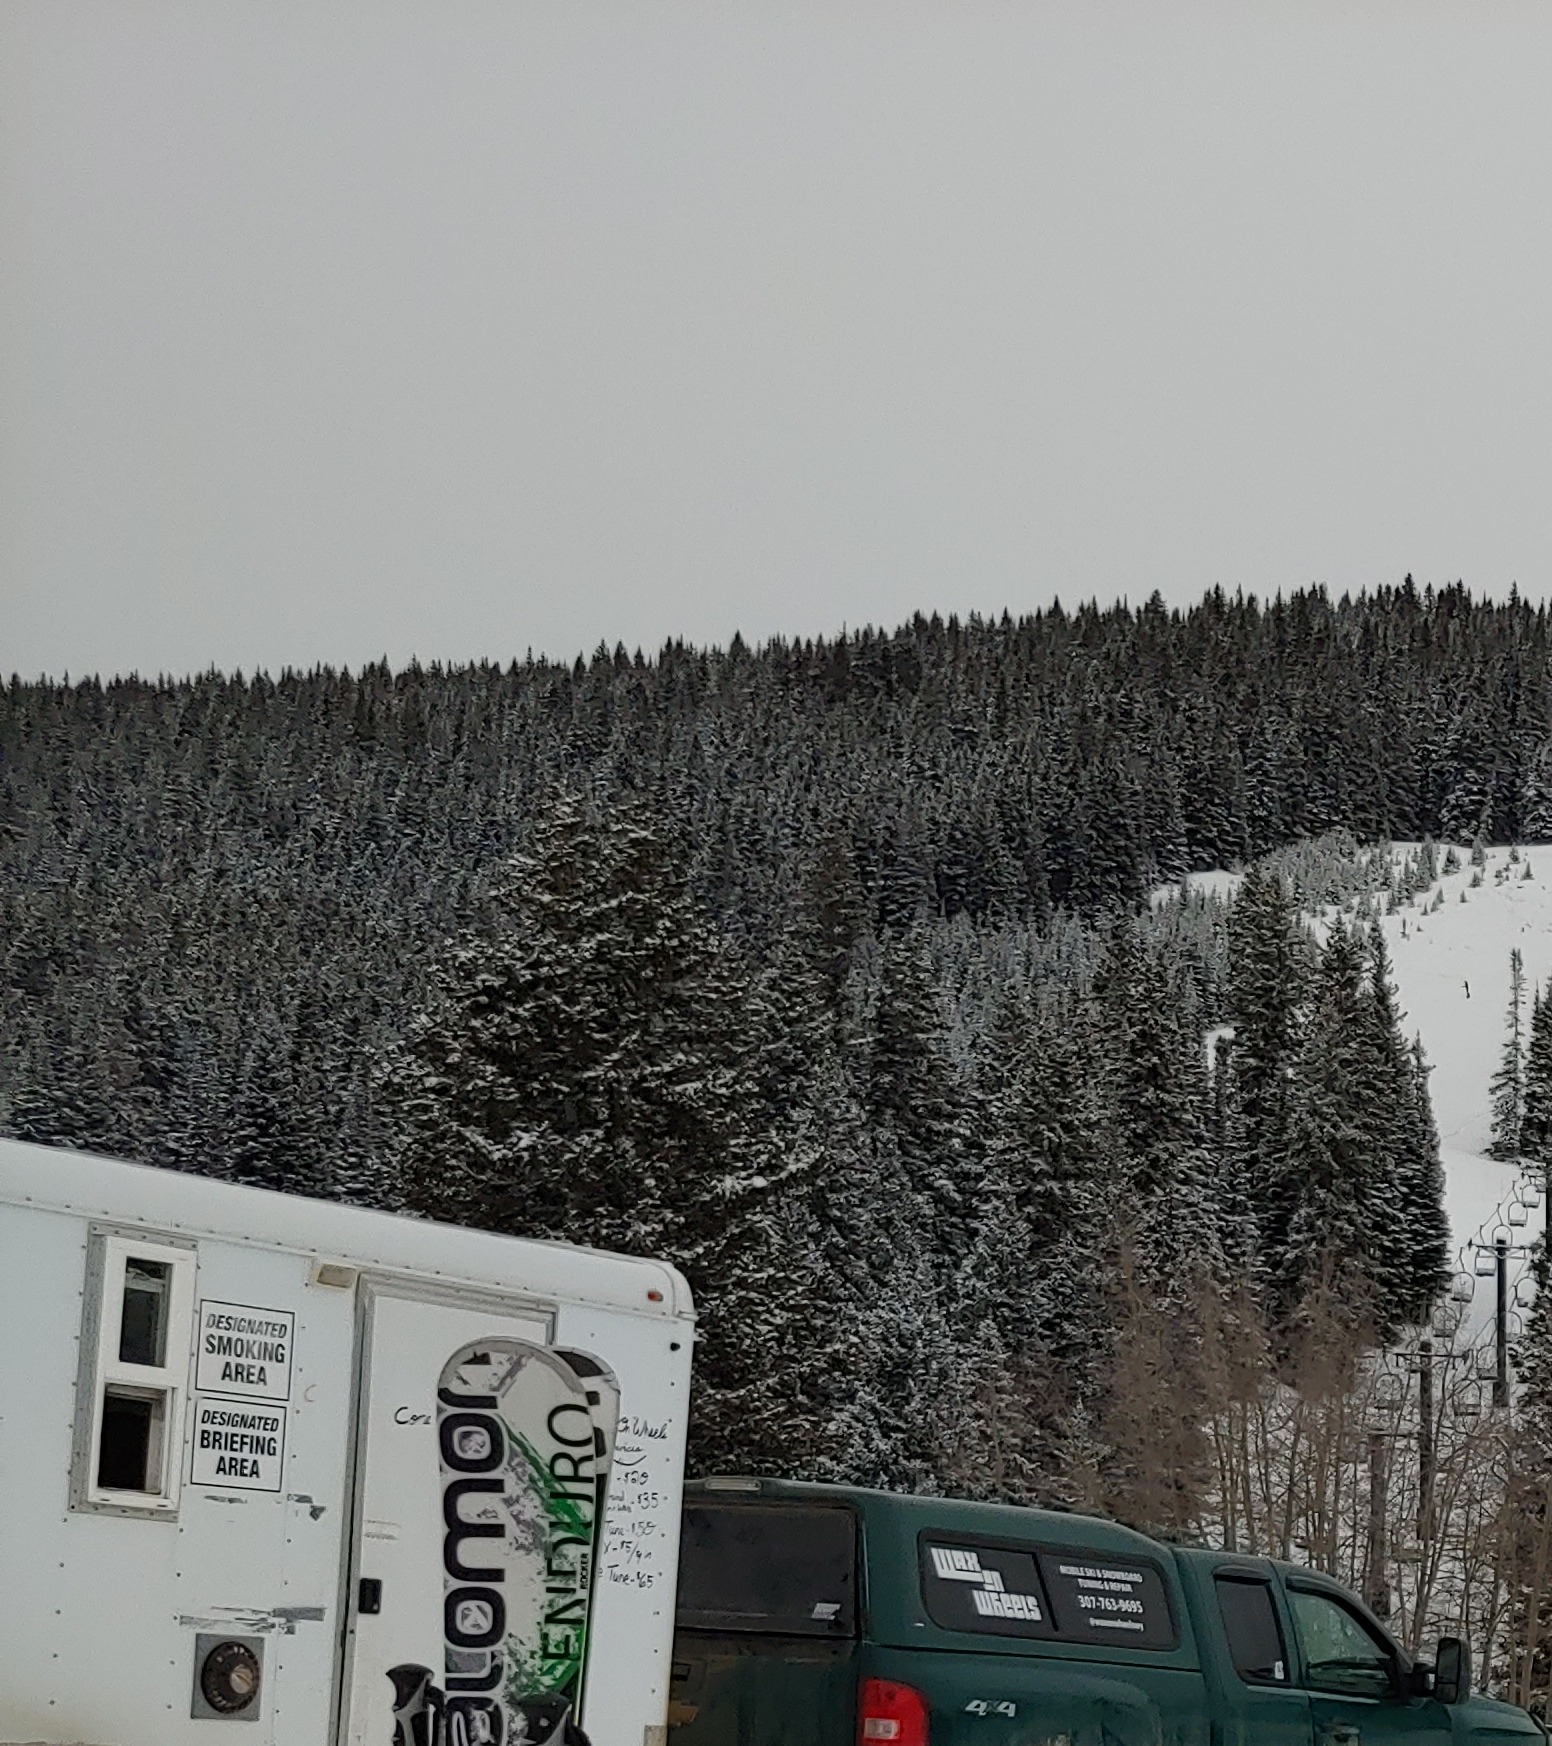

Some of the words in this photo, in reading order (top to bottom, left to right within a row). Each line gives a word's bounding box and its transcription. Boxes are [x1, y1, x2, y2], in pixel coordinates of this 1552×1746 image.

[205, 1313, 288, 1339] DESIGNATED
[205, 1333, 286, 1364] SMOKING
[221, 1361, 268, 1386] AREA
[200, 1409, 280, 1433] DESIGNATED
[199, 1428, 278, 1457] BRIEFING
[215, 1455, 261, 1479] AREA
[1077, 1594, 1144, 1614] 307-763-9695
